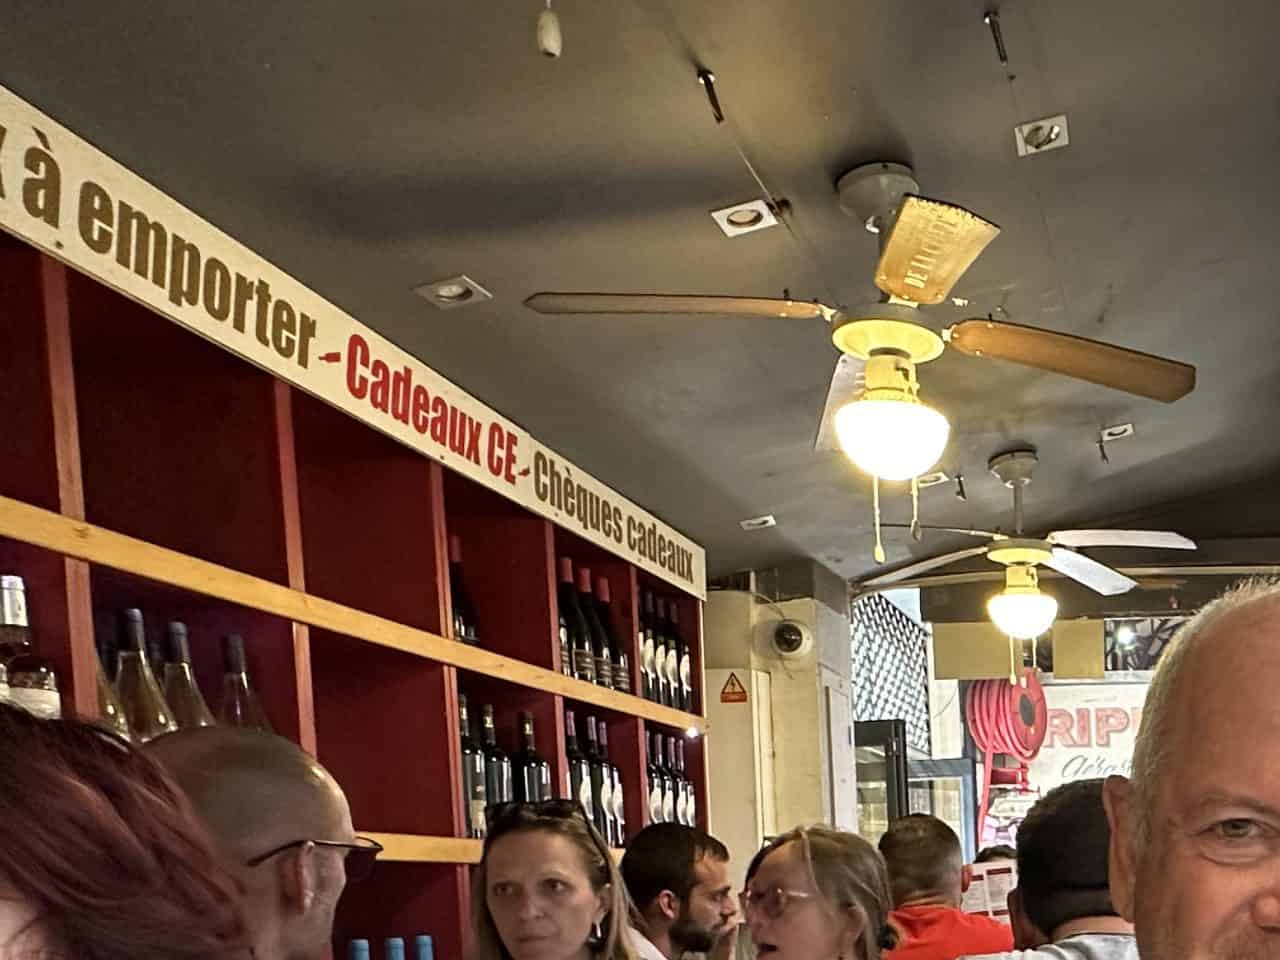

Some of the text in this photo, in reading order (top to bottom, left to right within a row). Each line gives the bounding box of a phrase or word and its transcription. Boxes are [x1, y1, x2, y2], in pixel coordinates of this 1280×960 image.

[22, 126, 61, 229] à
[78, 181, 316, 368] emporter
[346, 334, 481, 466] Cadeaux
[487, 422, 518, 485] CE
[534, 451, 622, 544] Chèques
[627, 514, 693, 584] cadeaux
[1043, 707, 1140, 748] RIP
